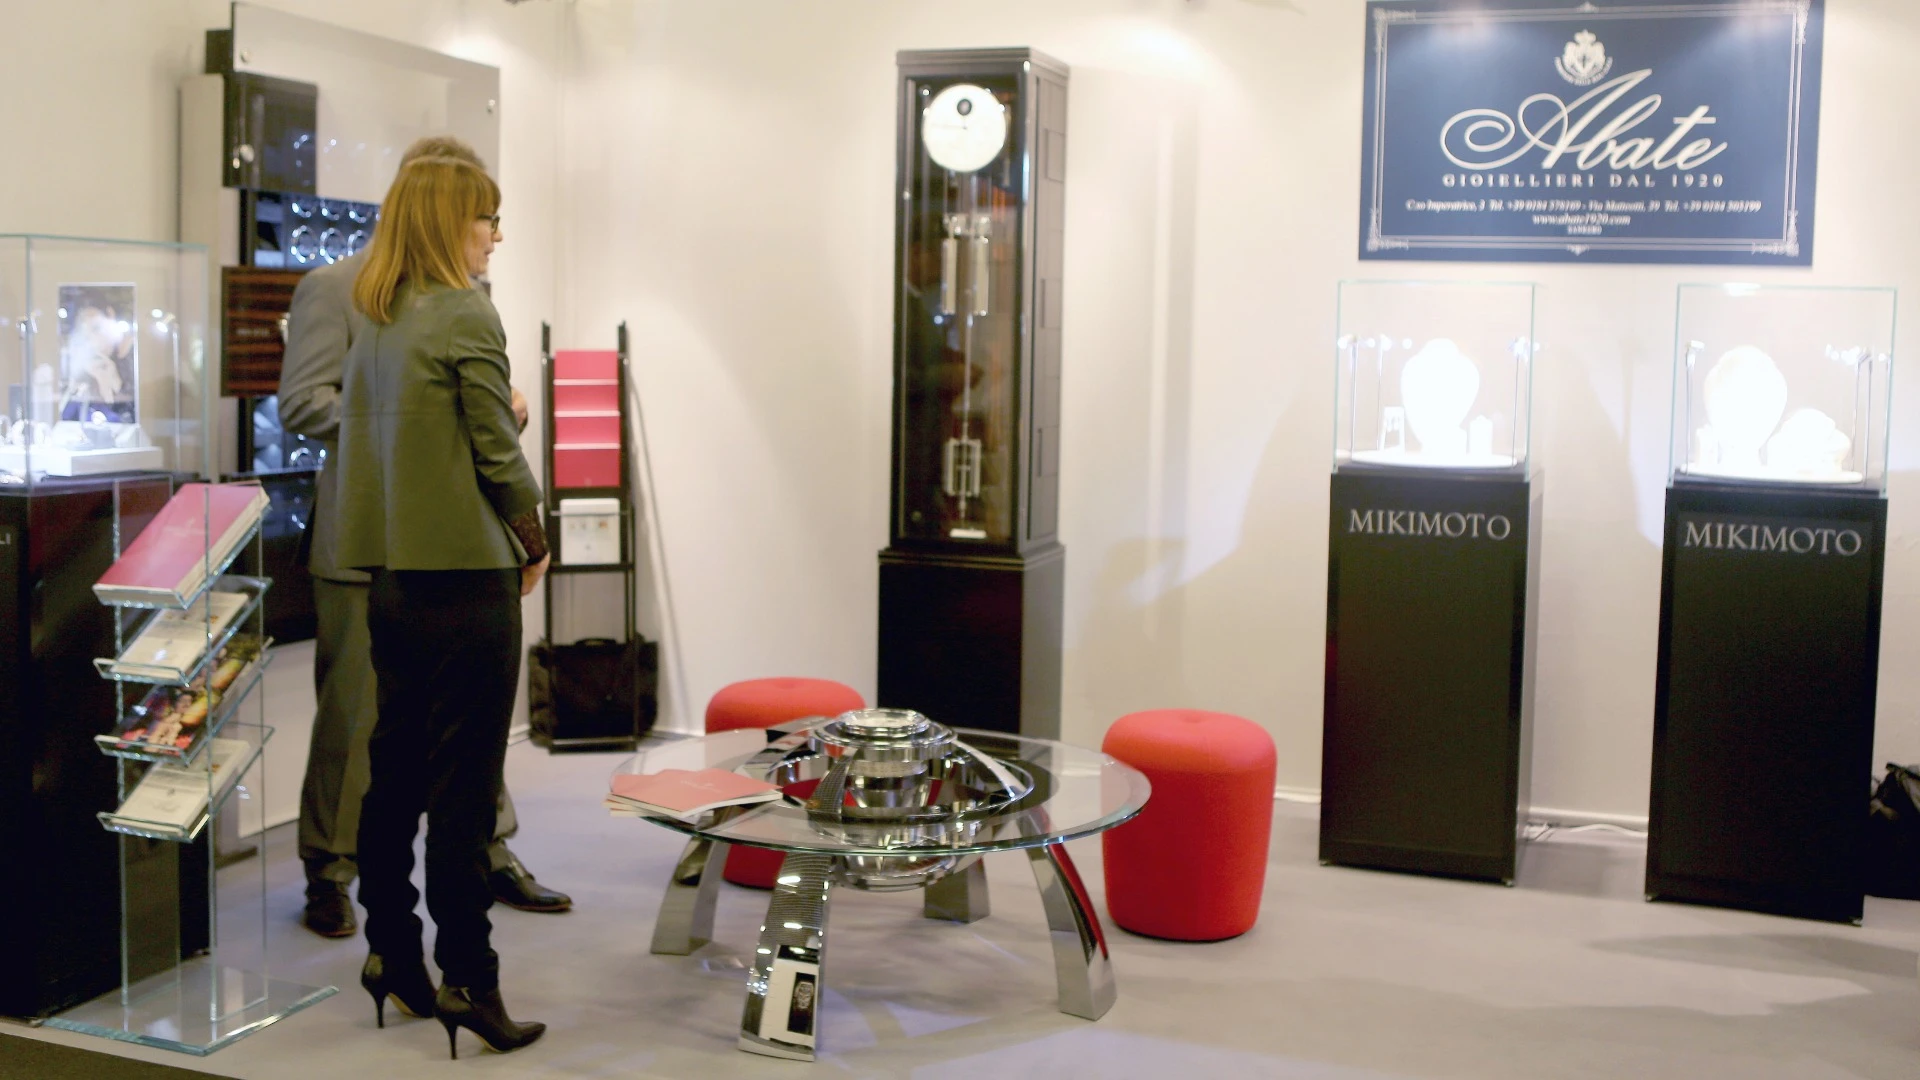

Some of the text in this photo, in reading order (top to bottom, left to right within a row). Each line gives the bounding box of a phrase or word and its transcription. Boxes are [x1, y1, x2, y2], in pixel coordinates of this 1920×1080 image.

[1440, 68, 1728, 170] Abate
[1442, 173, 1724, 188] GIOIELLIERI DAL 1920
[1349, 508, 1511, 541] MIKIMOTO
[1684, 520, 1862, 556] MIKIMOTO
